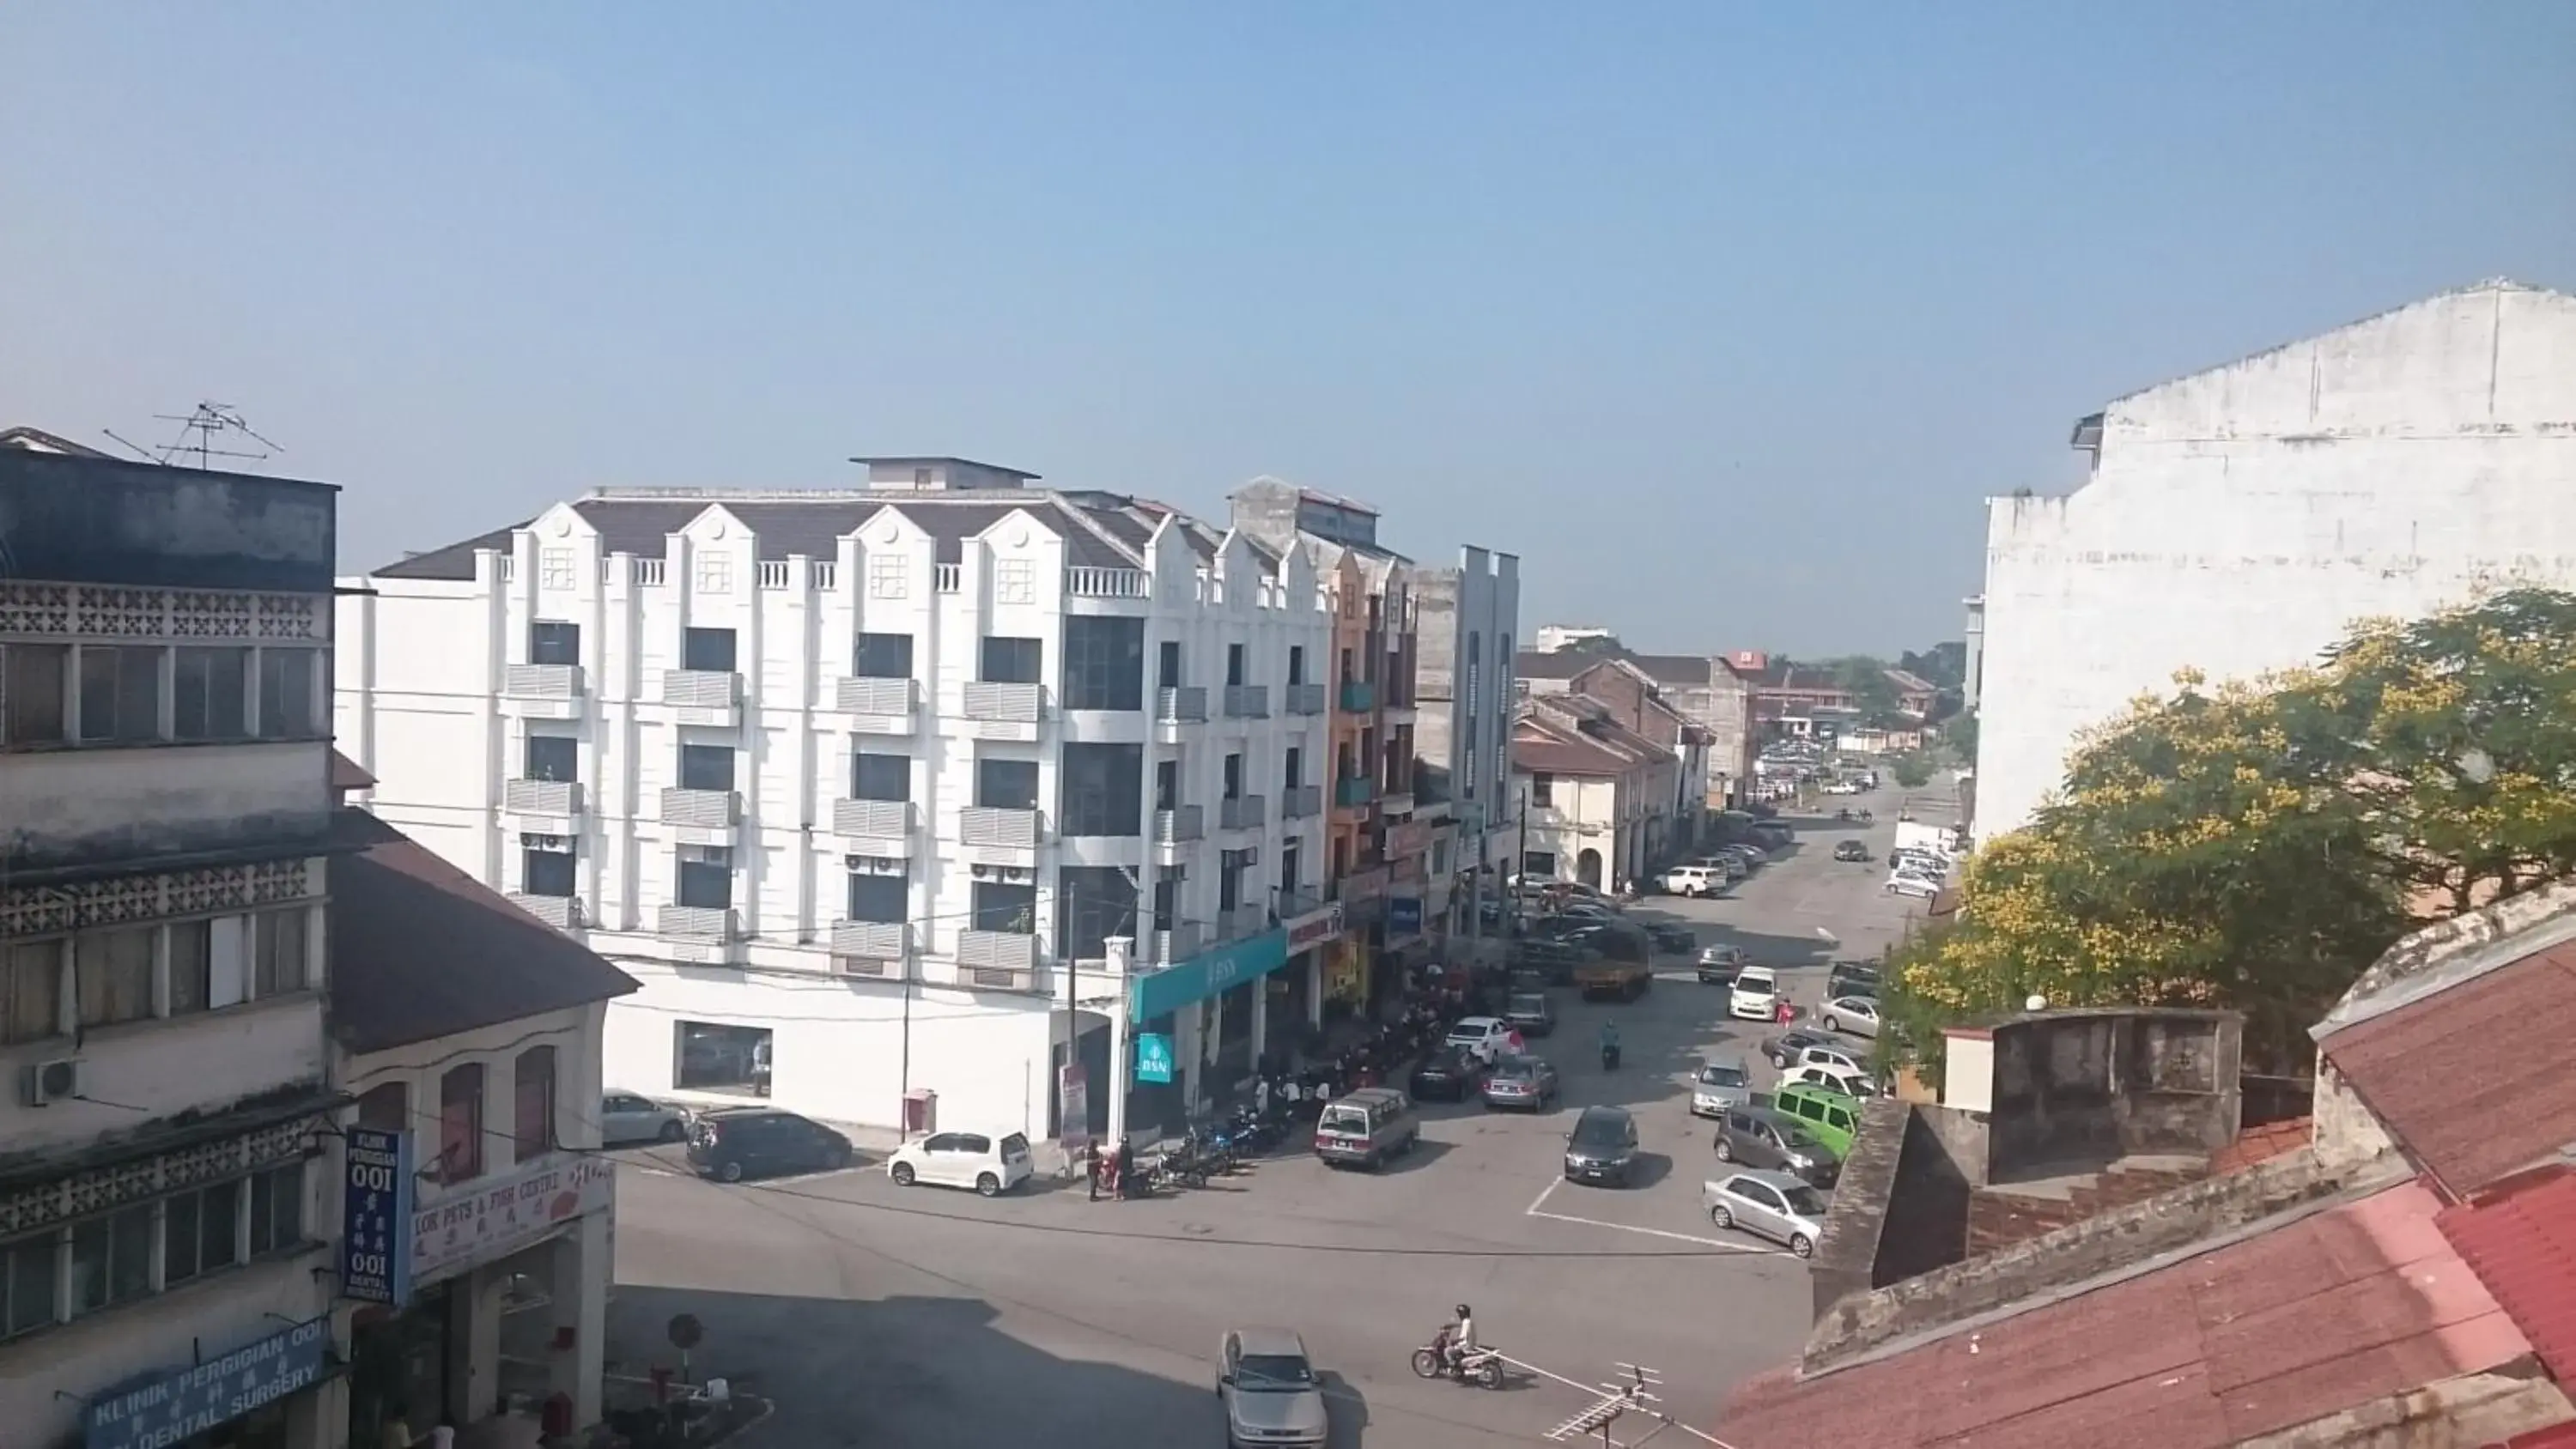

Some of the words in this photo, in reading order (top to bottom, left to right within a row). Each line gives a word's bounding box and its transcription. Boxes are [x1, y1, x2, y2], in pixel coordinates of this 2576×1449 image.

[1142, 1058, 1168, 1073] BSN
[352, 1164, 392, 1192] OOI
[443, 1200, 473, 1228] PETS
[489, 1185, 515, 1211] FISH
[519, 1172, 560, 1201] CENTRE
[351, 1252, 386, 1276] OOI
[350, 1274, 386, 1289] DENTAL
[95, 1381, 170, 1427] KLINIK
[179, 1335, 285, 1395] PERGIGIAN
[292, 1319, 322, 1347] OOI
[139, 1407, 226, 1449] DENTAL
[230, 1363, 317, 1416] SURGERY
